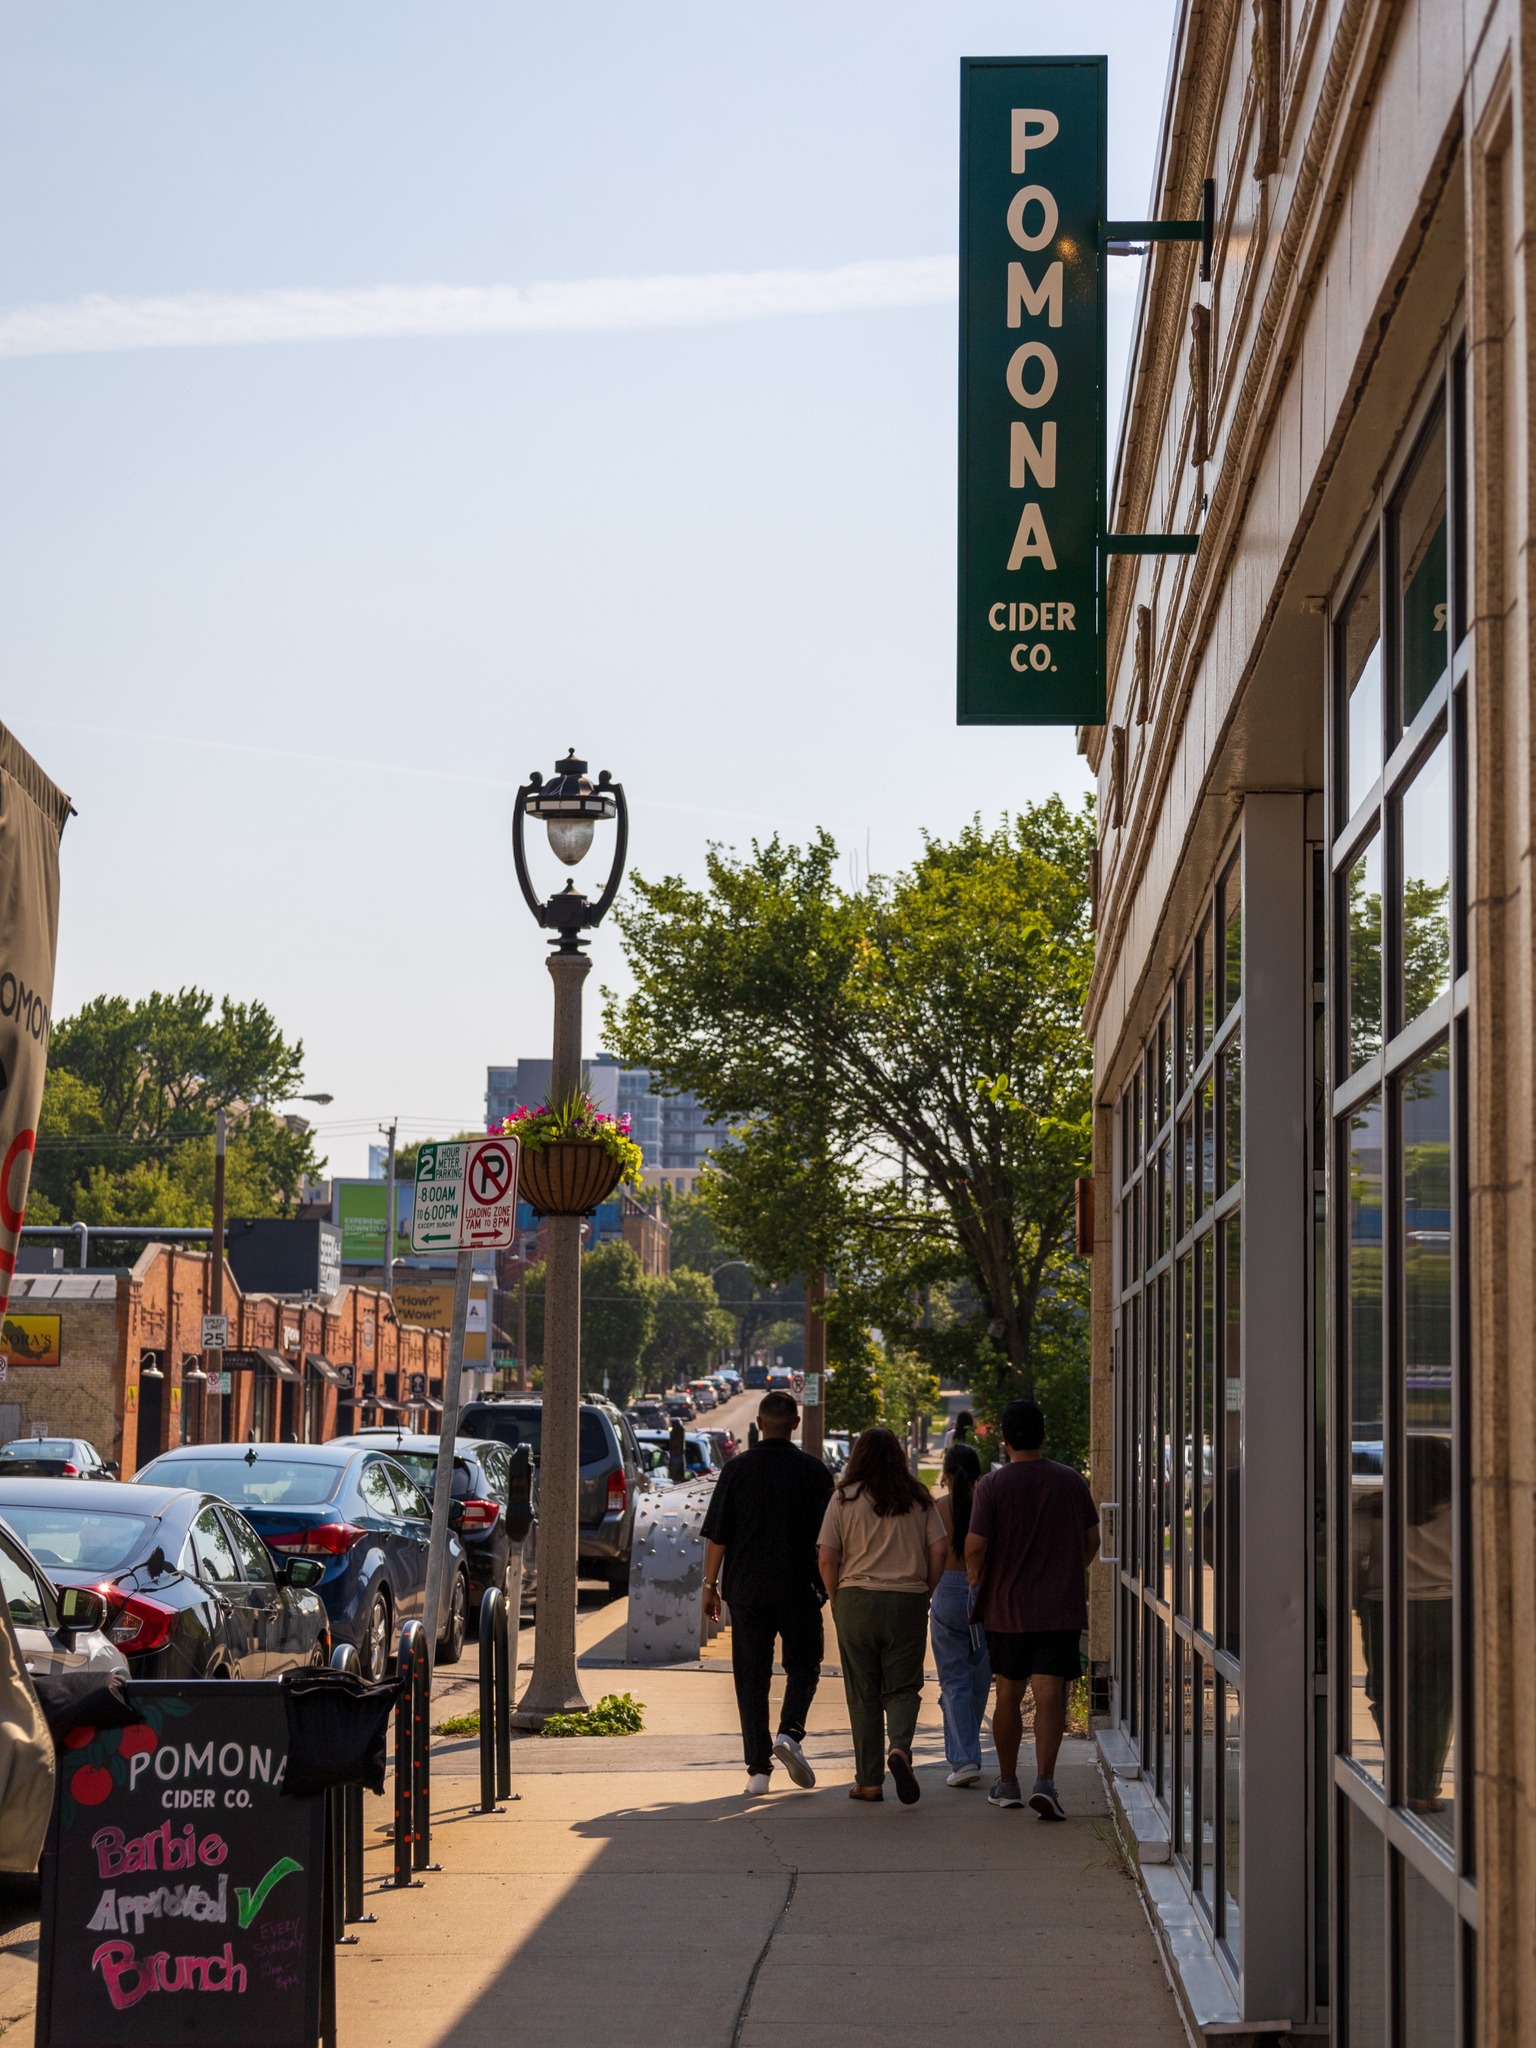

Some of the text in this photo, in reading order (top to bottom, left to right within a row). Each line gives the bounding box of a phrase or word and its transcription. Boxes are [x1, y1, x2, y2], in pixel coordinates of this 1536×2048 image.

[1006, 108, 1064, 571] POMONA
[989, 602, 1076, 632] CIDER
[1010, 643, 1059, 672] CO.
[441, 1147, 460, 1158] HOUR
[419, 1155, 434, 1180] 2
[438, 1158, 460, 1169] METER
[436, 1168, 463, 1179] PARKING
[421, 1186, 456, 1202] 8:00AM
[417, 1204, 458, 1221] TO 6:00PM
[466, 1205, 511, 1219] LOADING ZONE
[466, 1219, 481, 1230] 7AM
[484, 1219, 491, 1227] TO
[204, 1333, 225, 1346] 25
[162, 1789, 253, 1808] CIDER CO.
[92, 1819, 229, 1879] Barbie
[260, 1916, 301, 1939] EVERY
[92, 1939, 248, 2010] Brunch
